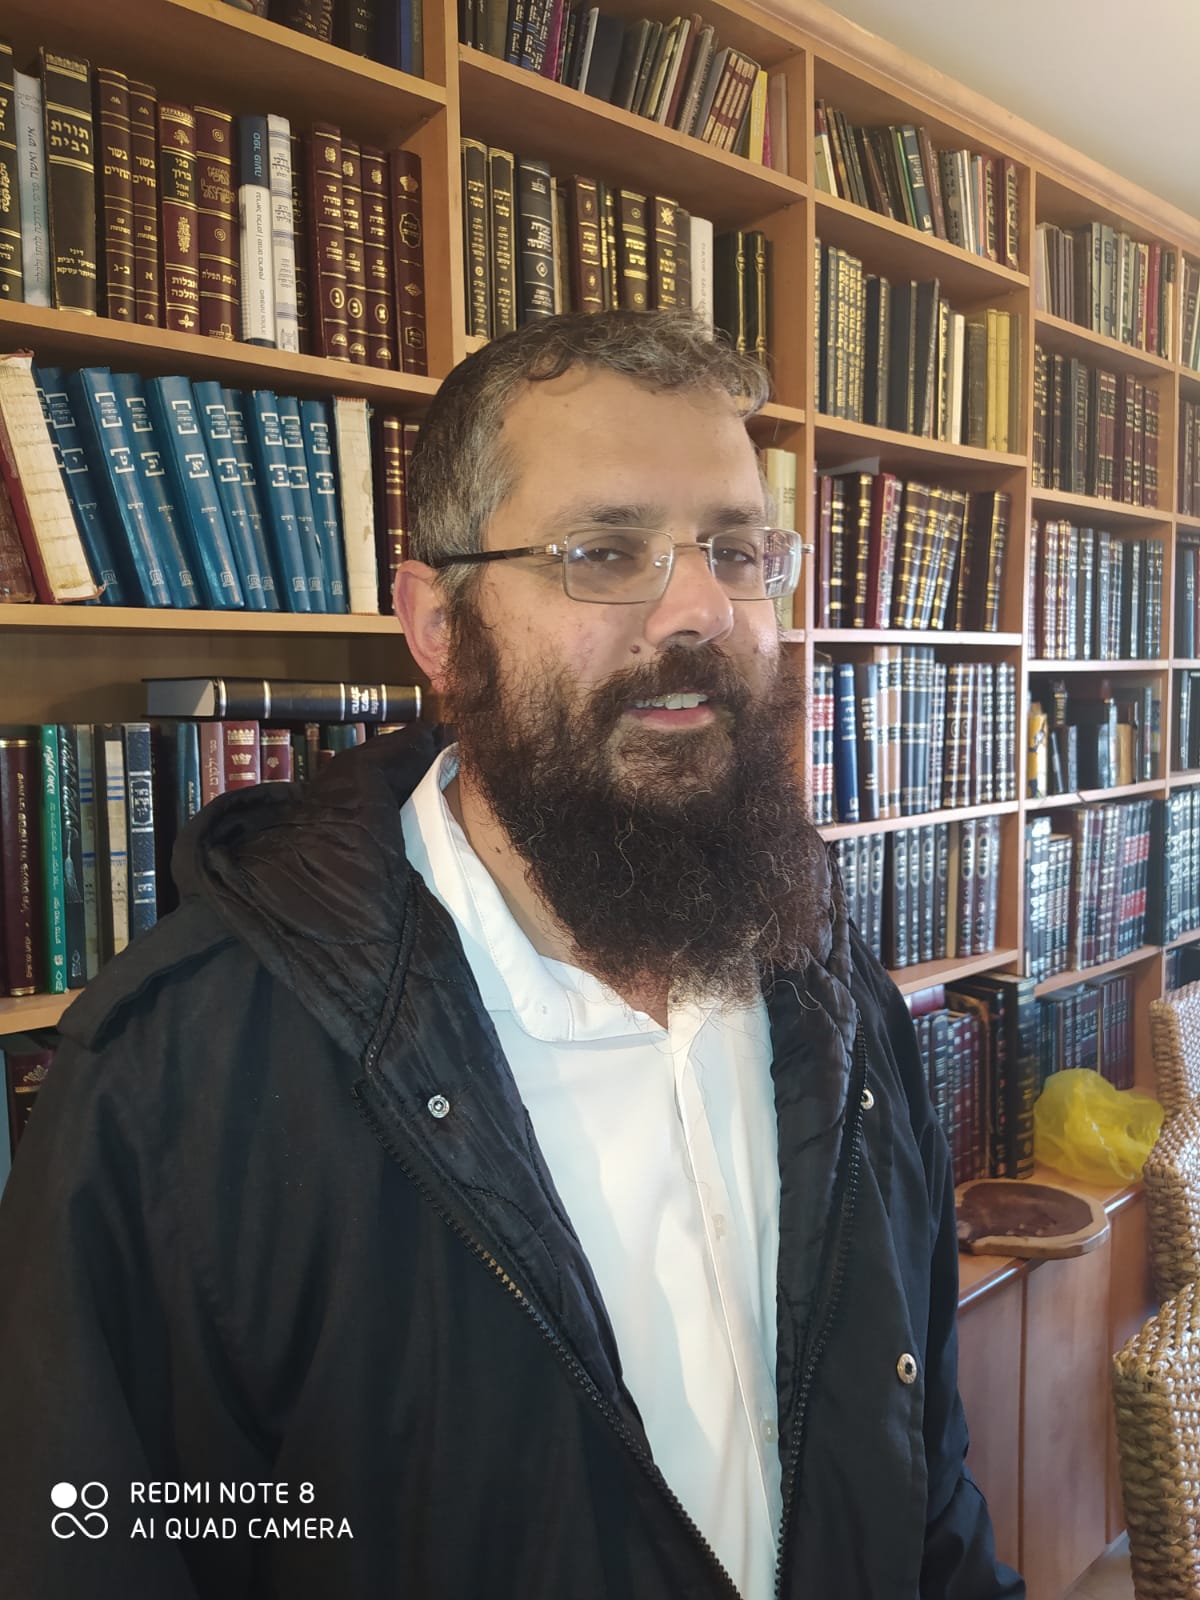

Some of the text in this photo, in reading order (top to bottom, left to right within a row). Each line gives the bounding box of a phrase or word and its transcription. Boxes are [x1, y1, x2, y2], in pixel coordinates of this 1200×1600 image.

[27, 126, 37, 147] איש
[50, 119, 89, 140] תורת
[50, 135, 89, 155] רבית
[107, 146, 128, 160] גשר
[252, 131, 262, 177] ספר פועה
[29, 151, 39, 179] ואשה
[135, 155, 155, 169] גשר
[104, 165, 132, 180] החיים
[144, 272, 153, 281] א
[205, 757, 220, 786] ילקוט
